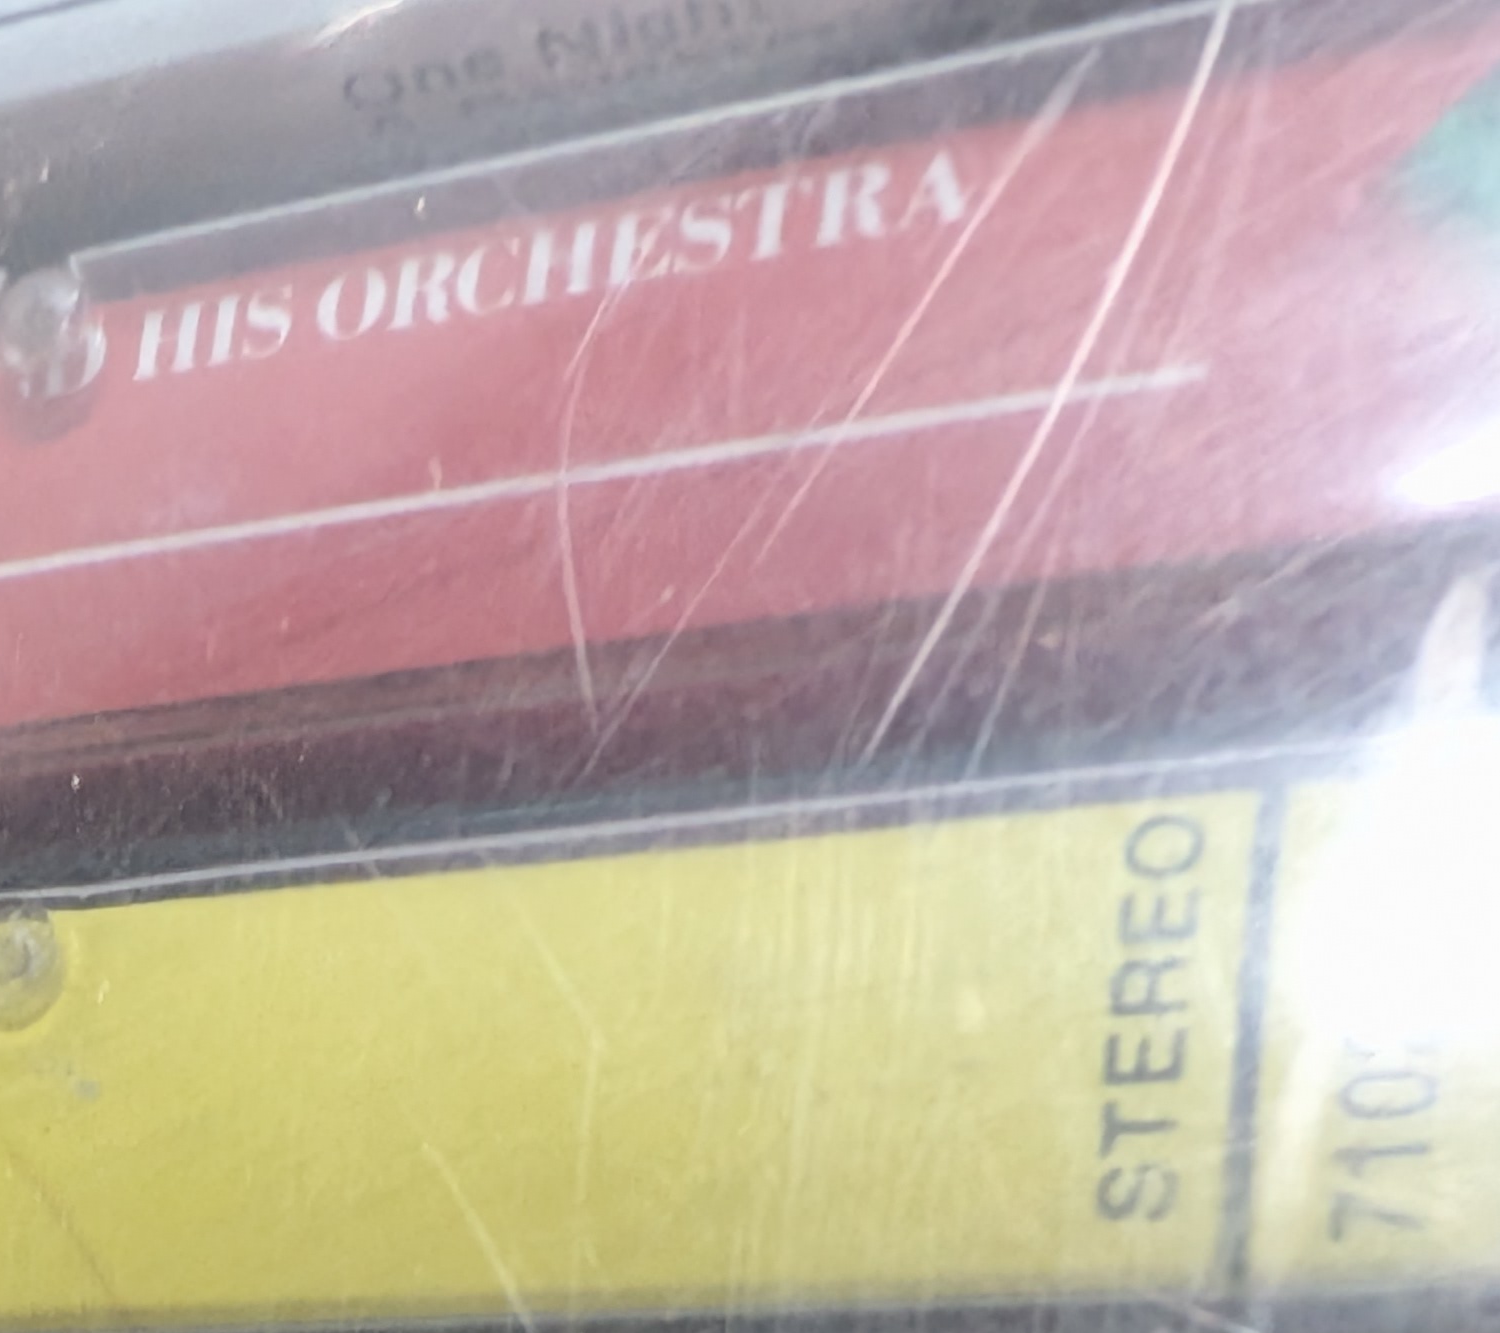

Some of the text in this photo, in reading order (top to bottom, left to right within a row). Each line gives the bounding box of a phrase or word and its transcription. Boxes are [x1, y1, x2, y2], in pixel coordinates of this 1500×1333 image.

[133, 285, 293, 382] HIS
[316, 150, 968, 342] ORCHESTRA
[1095, 811, 1205, 1223] STEREO
